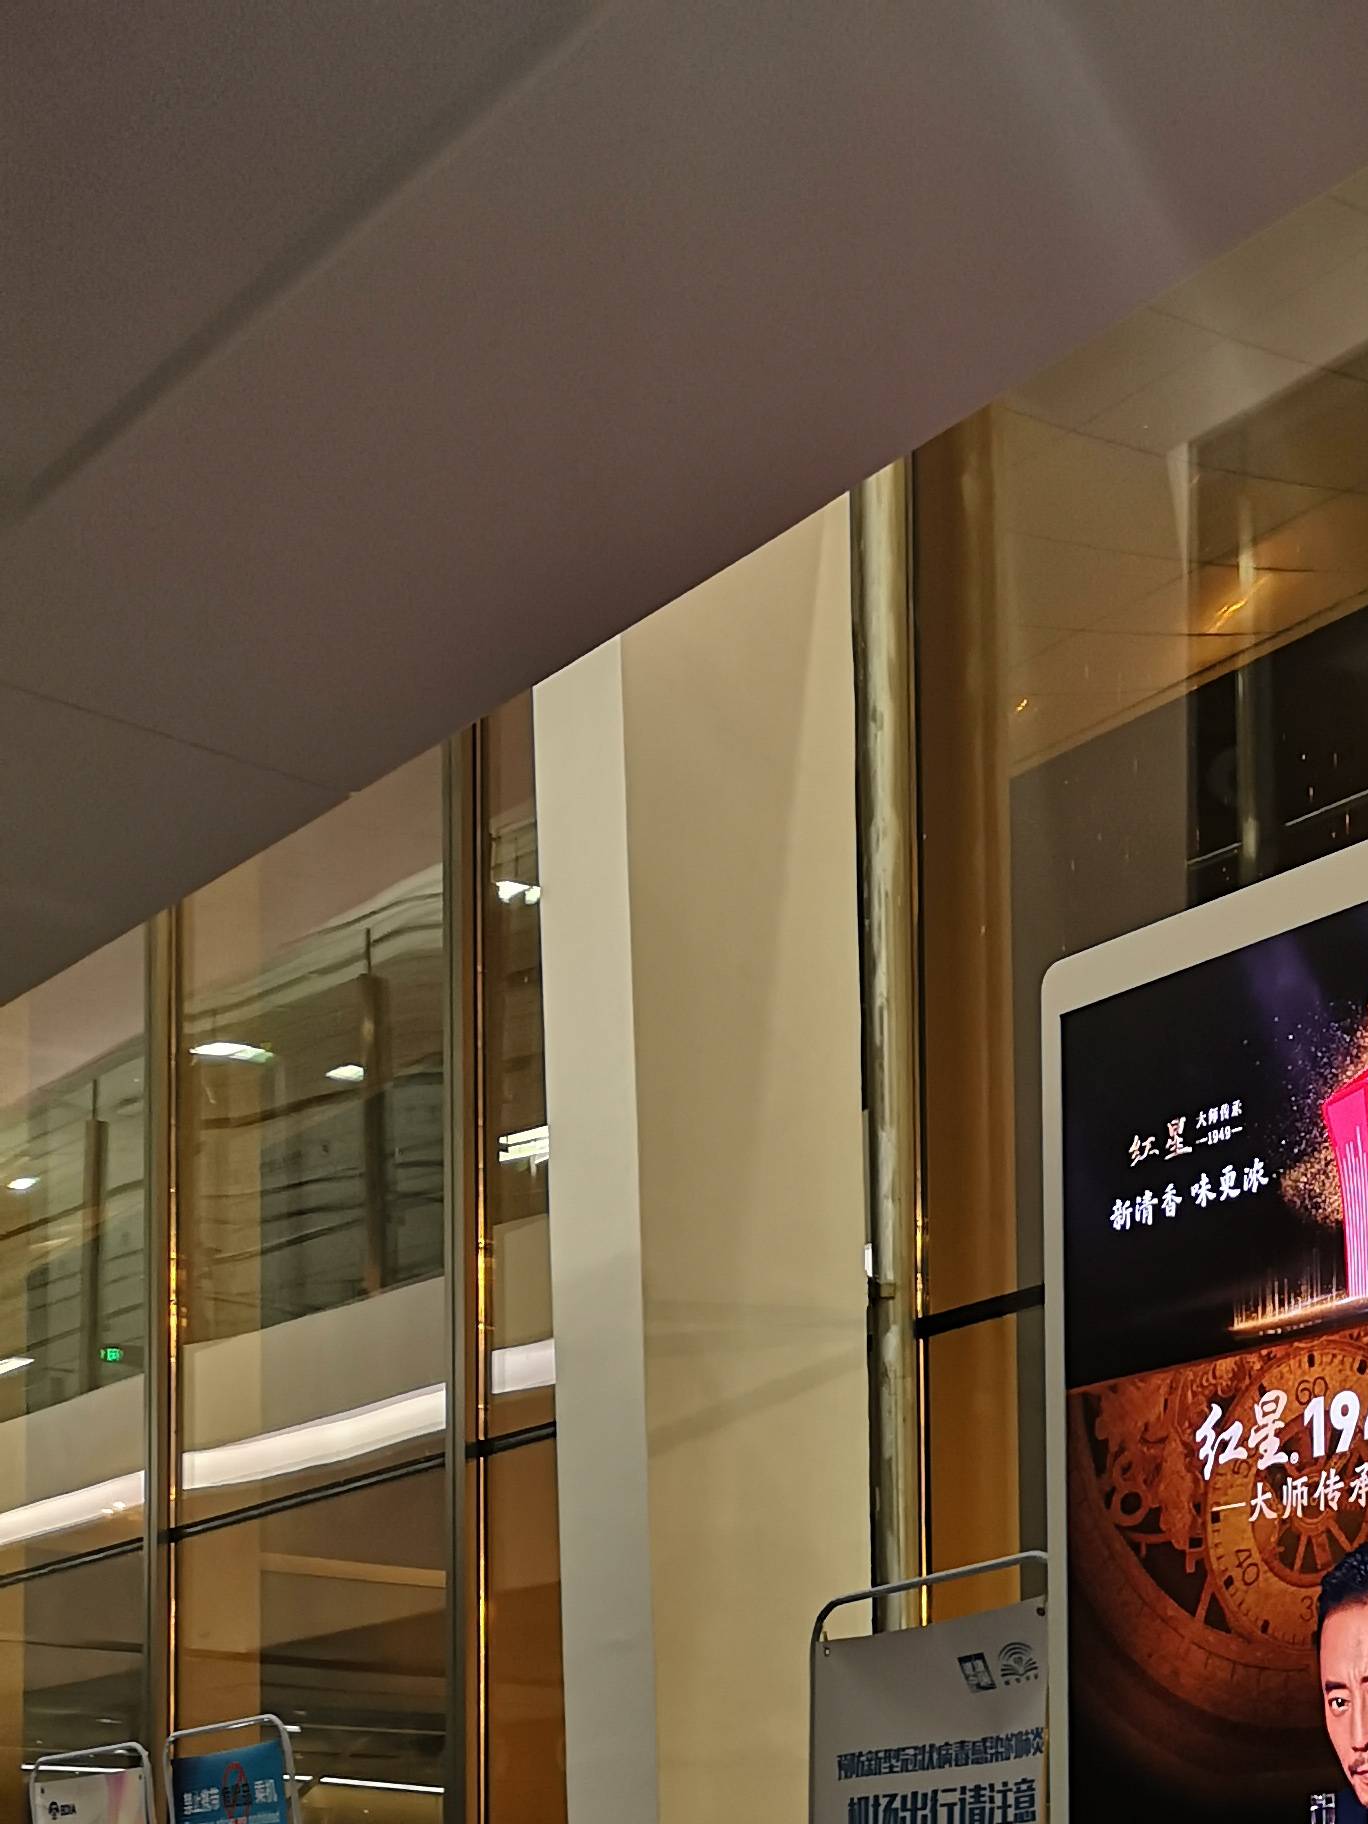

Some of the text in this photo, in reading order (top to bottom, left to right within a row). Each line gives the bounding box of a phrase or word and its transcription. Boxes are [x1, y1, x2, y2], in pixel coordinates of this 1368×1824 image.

[1128, 1116, 1193, 1167] 红星
[1207, 1125, 1232, 1146] 1949
[1109, 1157, 1269, 1230] 新清香 味更浓
